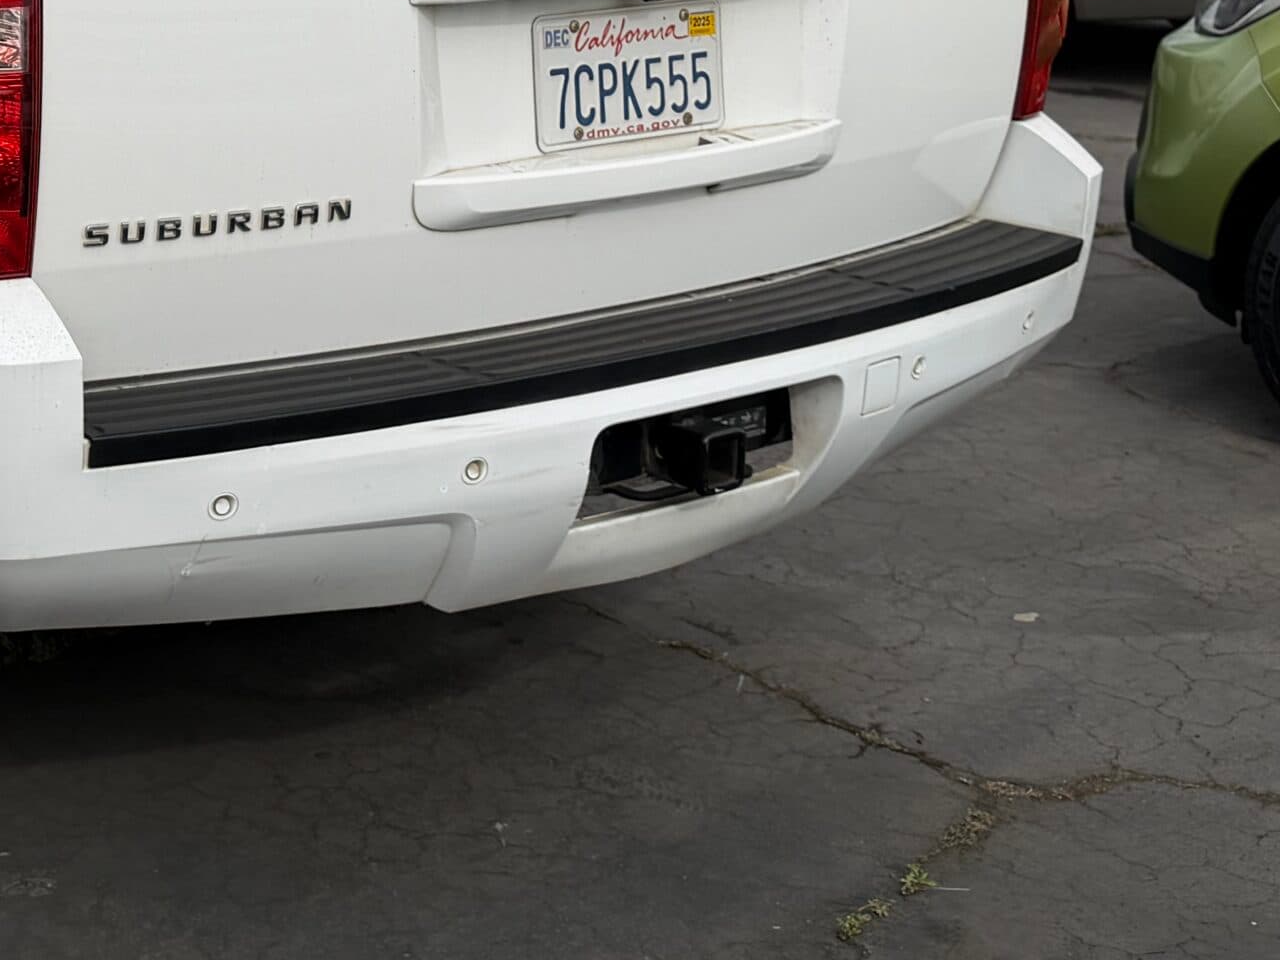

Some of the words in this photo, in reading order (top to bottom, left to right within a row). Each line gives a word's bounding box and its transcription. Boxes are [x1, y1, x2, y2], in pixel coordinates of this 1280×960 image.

[574, 16, 688, 57] California
[692, 15, 711, 28] 2025
[545, 29, 570, 48] DEC
[549, 50, 712, 130] 7CPK555
[586, 117, 681, 140] dmv.ca.gov
[82, 198, 352, 248] SUBURBAN
